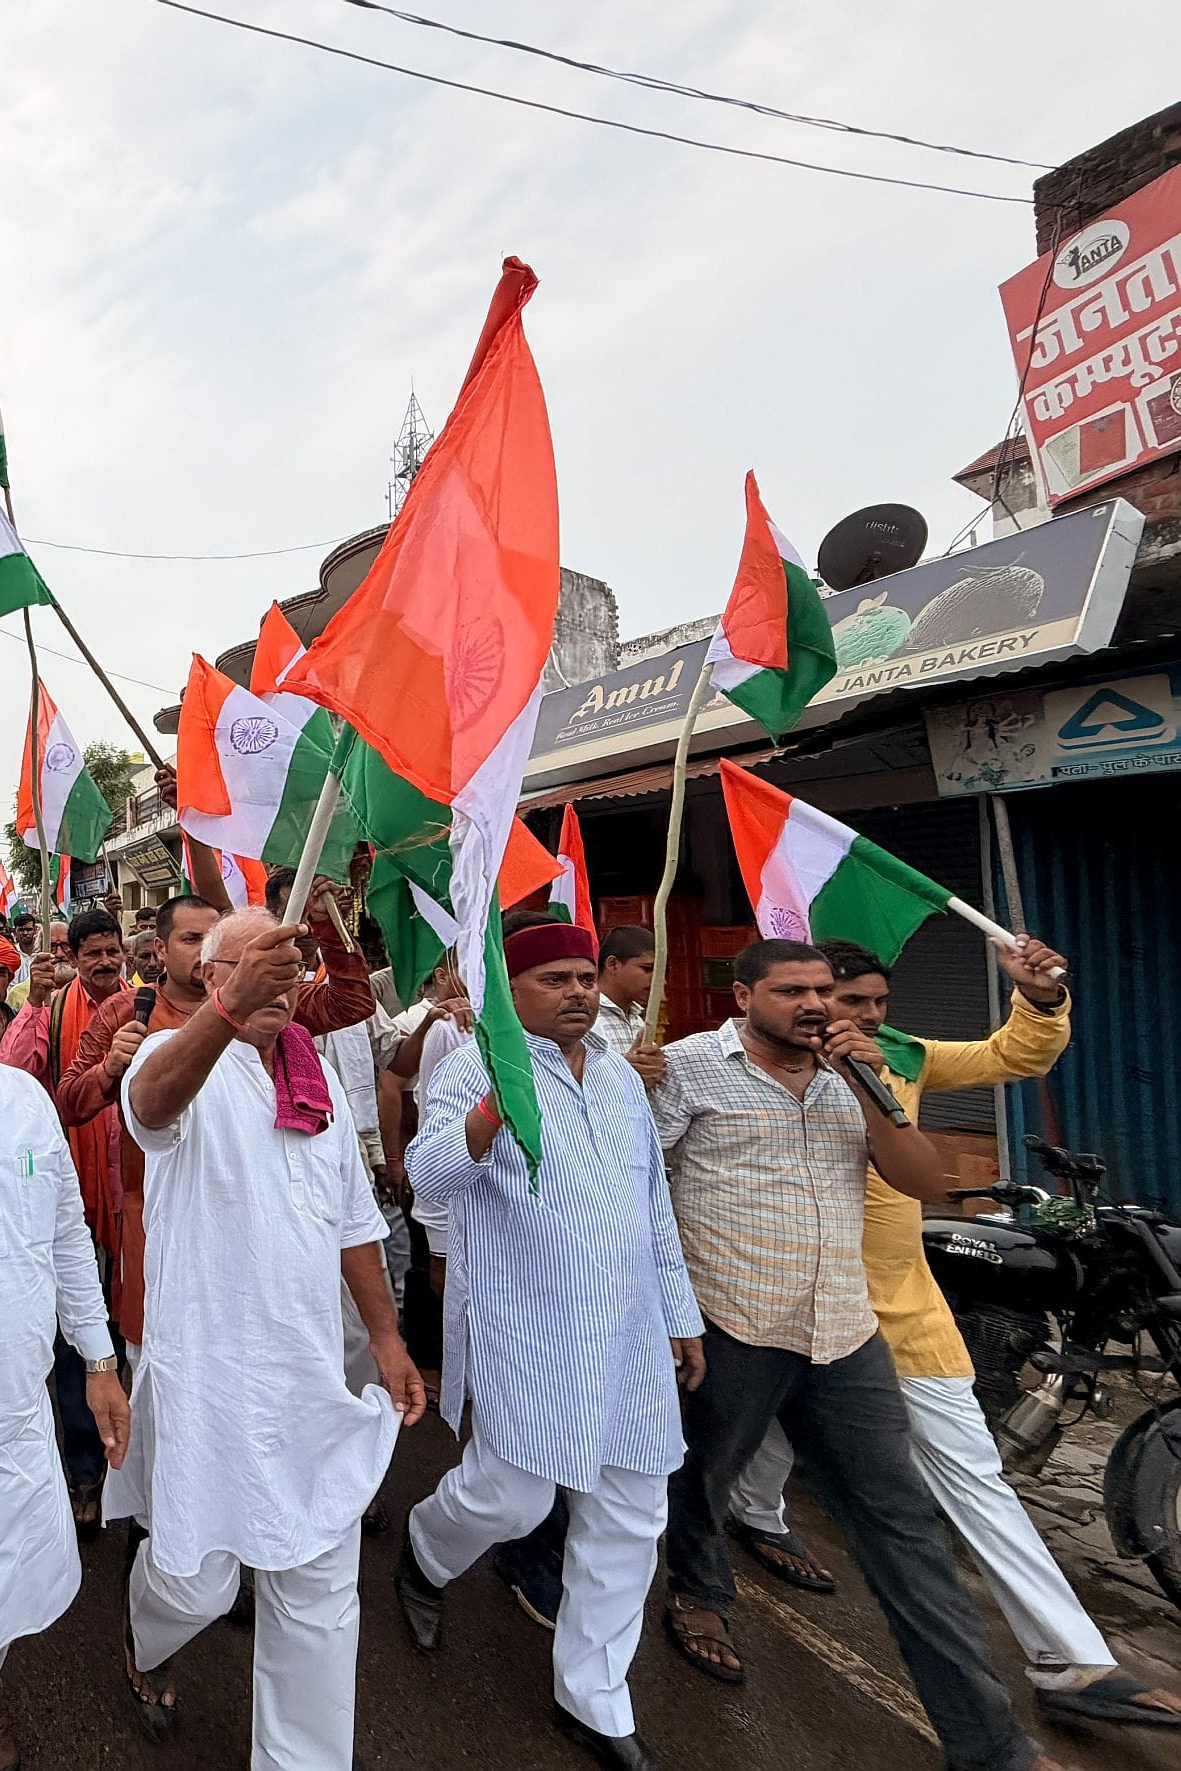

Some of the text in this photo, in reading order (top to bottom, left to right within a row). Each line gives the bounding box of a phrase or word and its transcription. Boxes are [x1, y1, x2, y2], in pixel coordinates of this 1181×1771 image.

[1067, 235, 1123, 281] JANTA
[1025, 307, 1181, 421] कम्प्यूट
[836, 631, 1039, 693] JANTA BAKERY
[570, 659, 685, 724] Amul
[602, 714, 624, 727] Real
[625, 710, 640, 721] Ice
[1132, 753, 1150, 768] के
[946, 1243, 1003, 1264] ENFIELD
[951, 1233, 997, 1253] ROYAL
